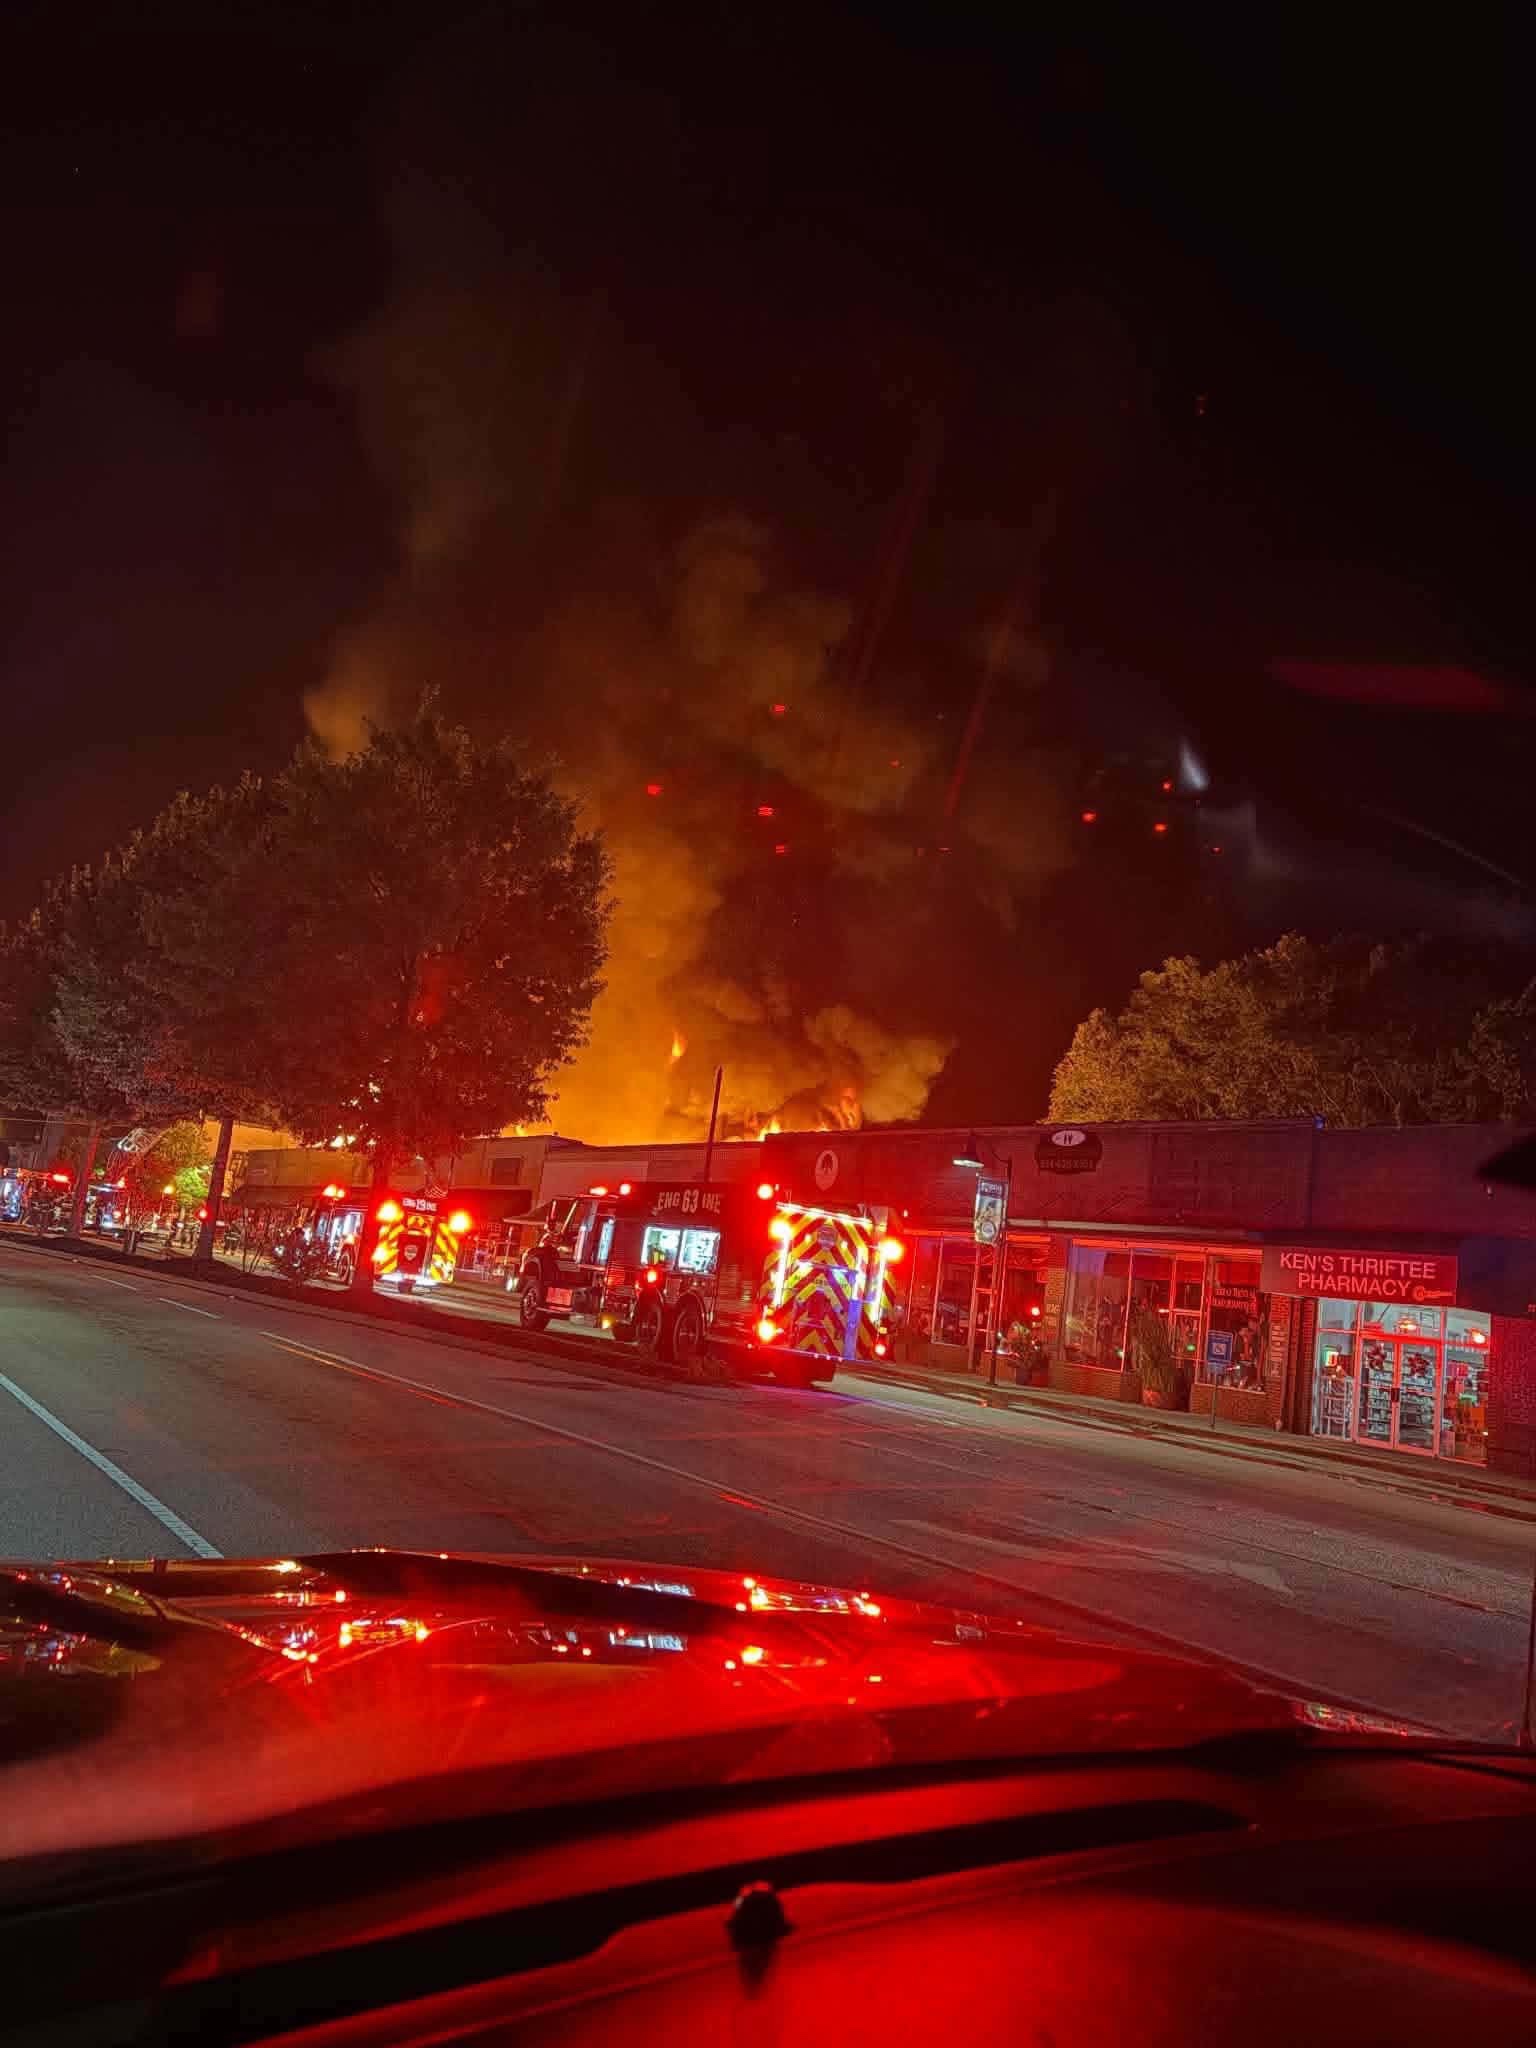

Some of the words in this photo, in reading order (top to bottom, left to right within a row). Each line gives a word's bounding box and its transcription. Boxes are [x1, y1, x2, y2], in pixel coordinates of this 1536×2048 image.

[657, 1192, 680, 1211] ENG
[681, 1189, 699, 1213] 63
[1280, 1253, 1334, 1272] KEN'S
[1339, 1256, 1437, 1279] THRIFTEE
[1298, 1272, 1412, 1297] PHARMACY
